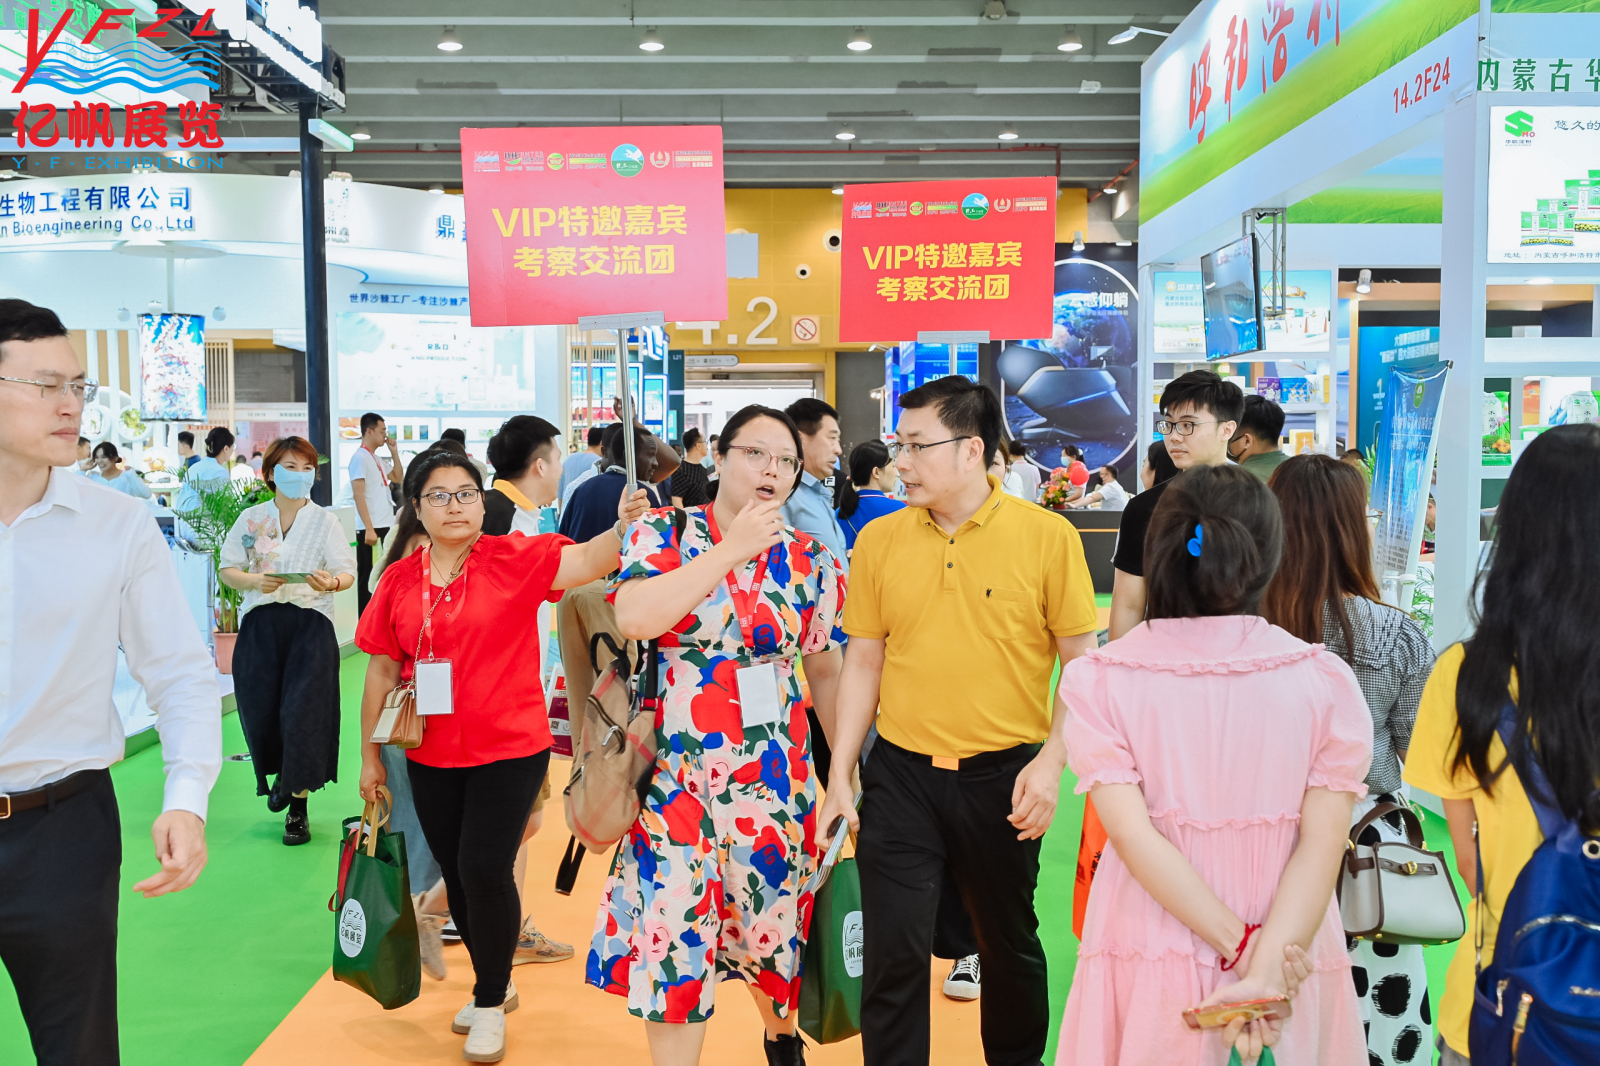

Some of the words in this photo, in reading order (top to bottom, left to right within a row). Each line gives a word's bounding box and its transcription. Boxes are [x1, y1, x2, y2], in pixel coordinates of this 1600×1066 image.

[1393, 56, 1450, 114] 14.2F24
[1477, 58, 1600, 93] 内蒙古华
[1554, 119, 1600, 131] 悠久的
[0, 186, 191, 217] 生物工程有限公司
[13, 216, 123, 235] Bioengineering
[491, 204, 688, 238] VIP特邀嘉宾
[513, 244, 675, 278] 考察交流团
[862, 241, 1023, 270] VIP特邀嘉宾
[876, 274, 1010, 302] 考察交流团
